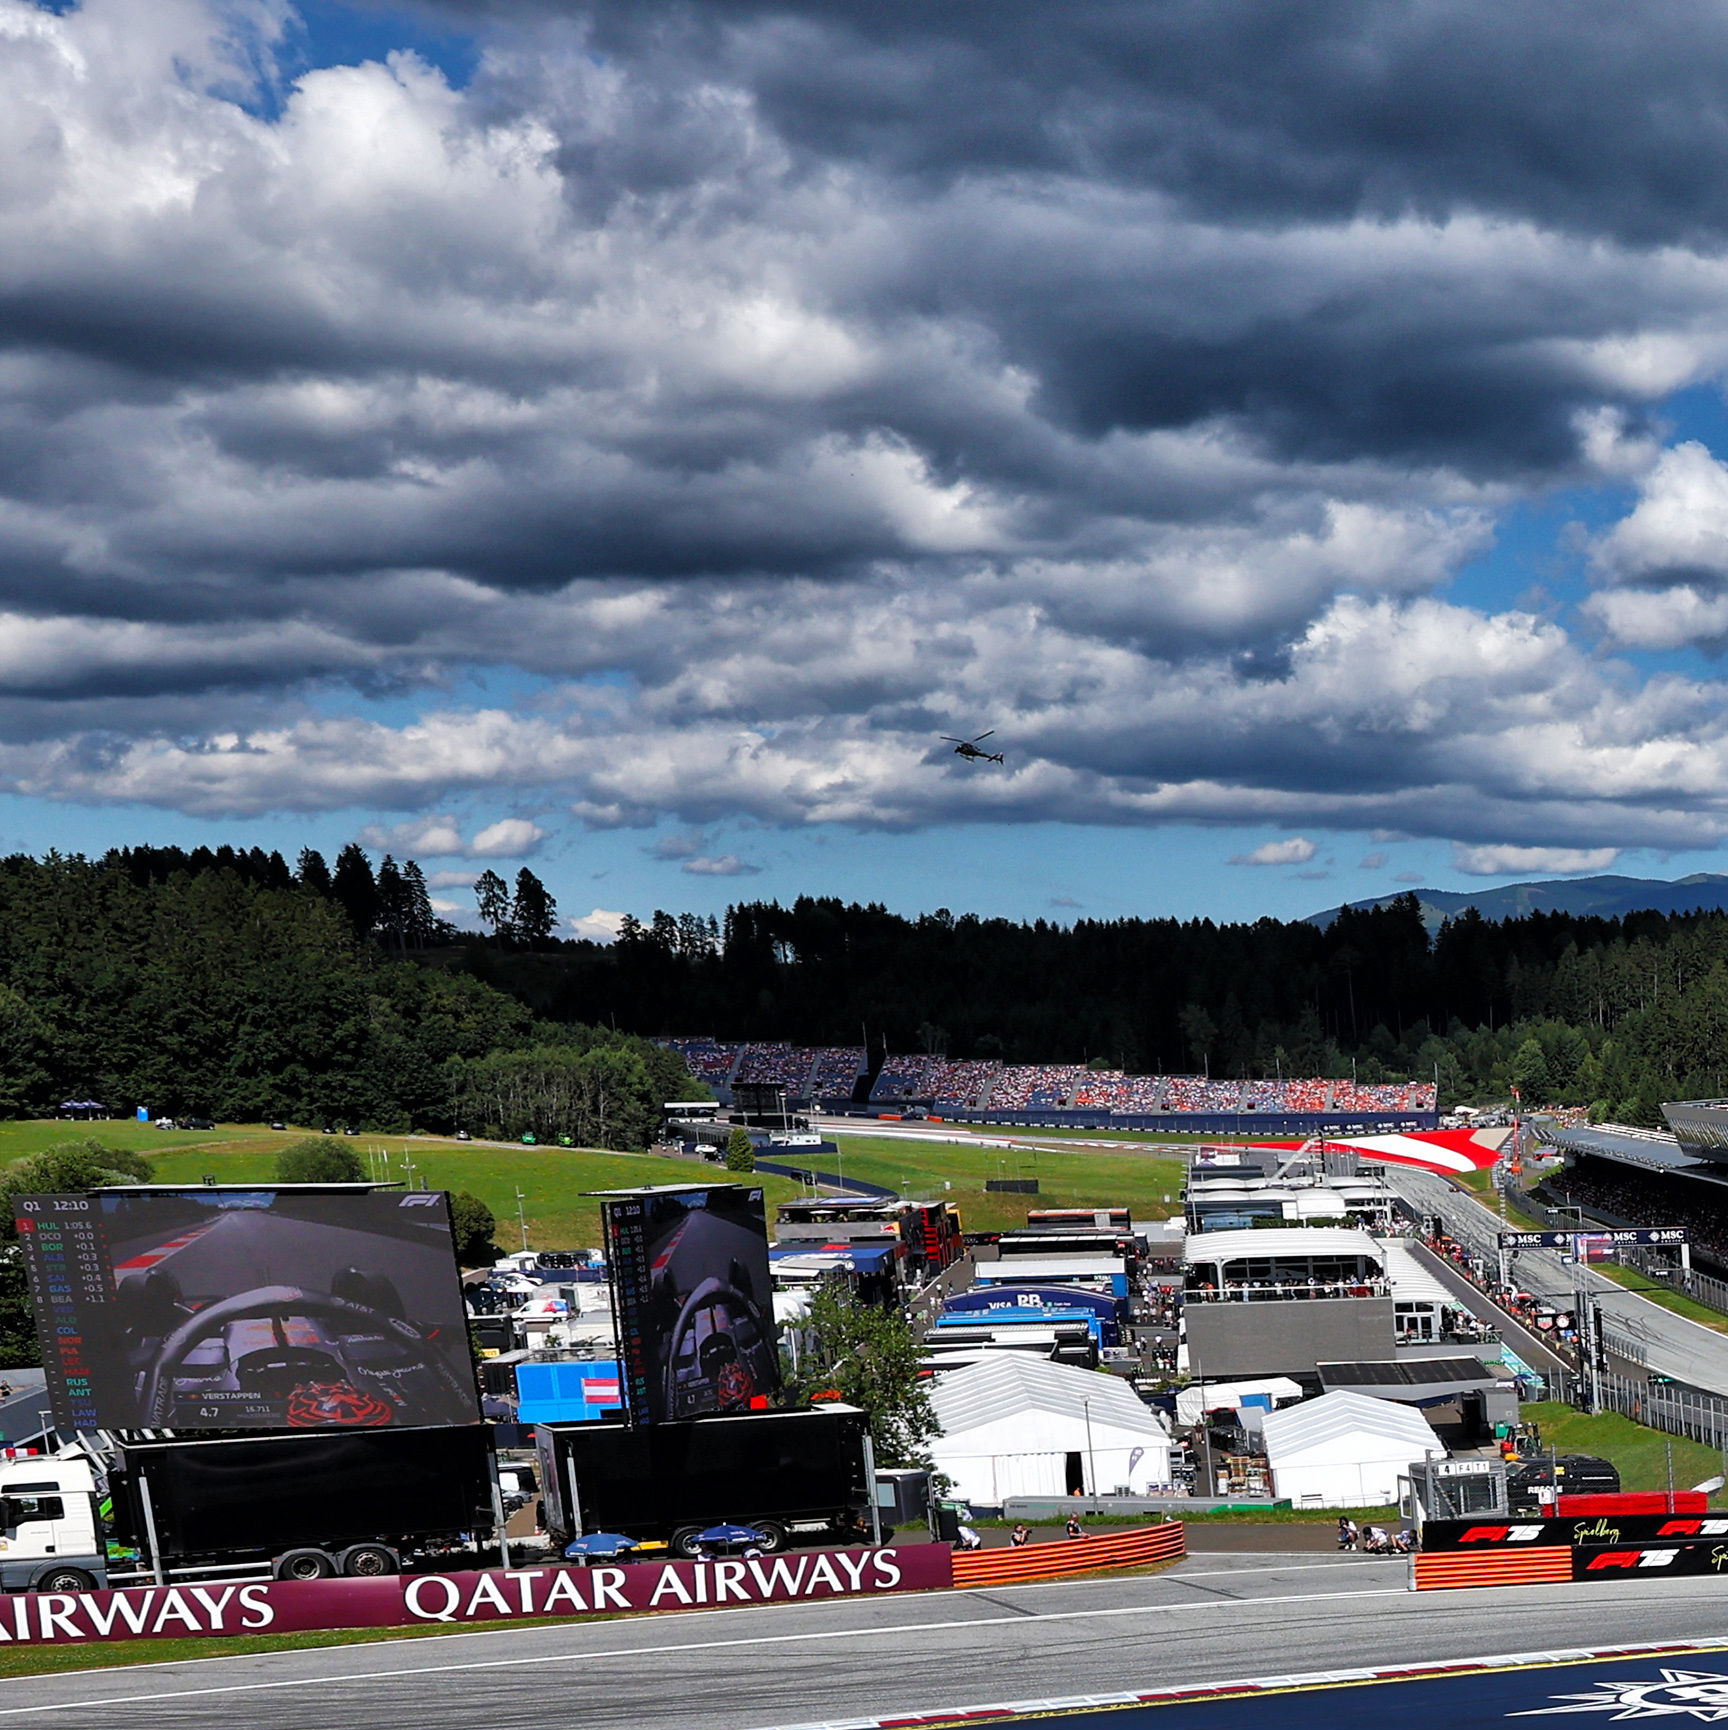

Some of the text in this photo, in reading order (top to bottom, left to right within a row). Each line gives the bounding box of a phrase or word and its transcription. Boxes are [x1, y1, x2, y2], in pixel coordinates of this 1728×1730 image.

[23, 1200, 89, 1213] Q1 12:10
[37, 1221, 59, 1230] HUL
[64, 1221, 92, 1230] 1:05.6
[1517, 1234, 1542, 1245] MSC
[1613, 1231, 1637, 1241] MSC
[1660, 1230, 1684, 1240] MSC
[41, 1243, 64, 1251] BOR
[49, 1284, 72, 1293] GAS
[988, 1301, 1012, 1310] VISA
[56, 1326, 78, 1335] COL
[66, 1378, 88, 1386] RUS
[68, 1388, 92, 1396] ANT
[201, 1391, 261, 1400] VERSTAPPEN
[72, 1409, 97, 1417] LAW
[200, 1406, 219, 1418] 4.7
[1443, 1462, 1488, 1475] 4 F4 T1
[1573, 1518, 1621, 1545] Spielberg
[404, 1547, 902, 1622] QATAR AIRWAYS
